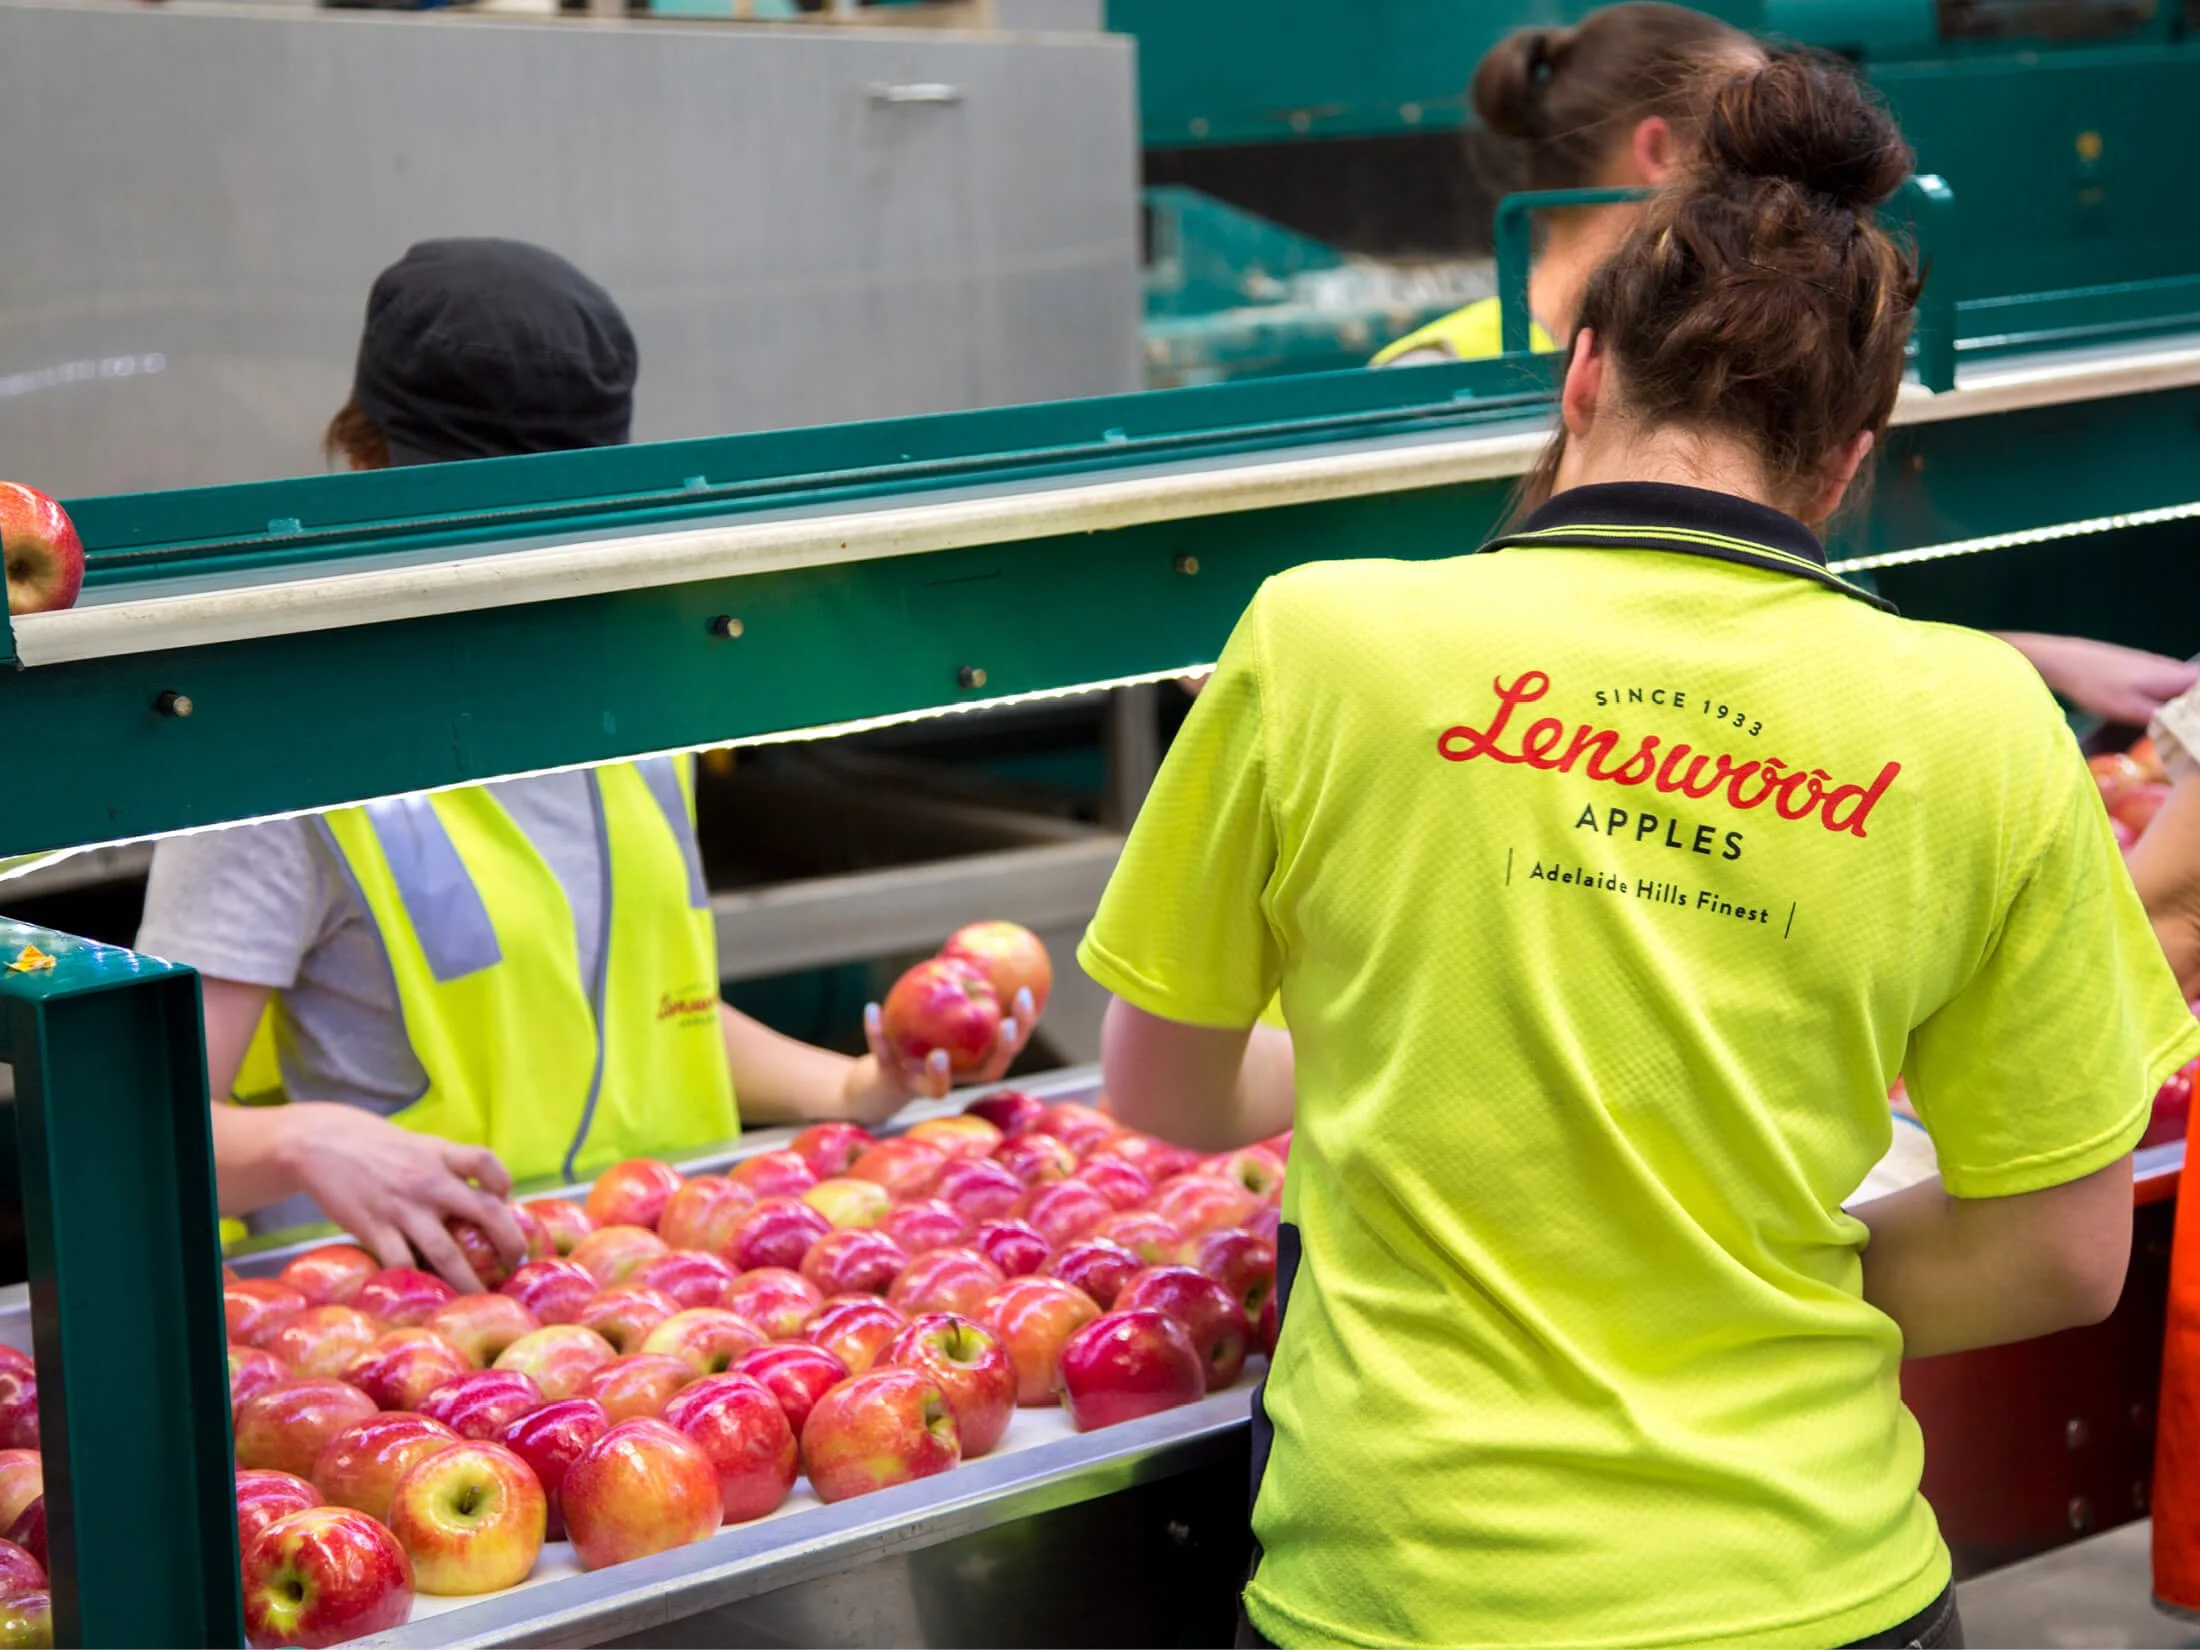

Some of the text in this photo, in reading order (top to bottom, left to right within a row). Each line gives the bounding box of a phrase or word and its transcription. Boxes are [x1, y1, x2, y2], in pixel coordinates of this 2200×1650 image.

[1595, 688, 1764, 737] SINCE 1933
[1437, 670, 1902, 838] Lenswood
[1575, 803, 1746, 861] APPLES
[1529, 862, 1770, 924] Adelaide Hills Finest
